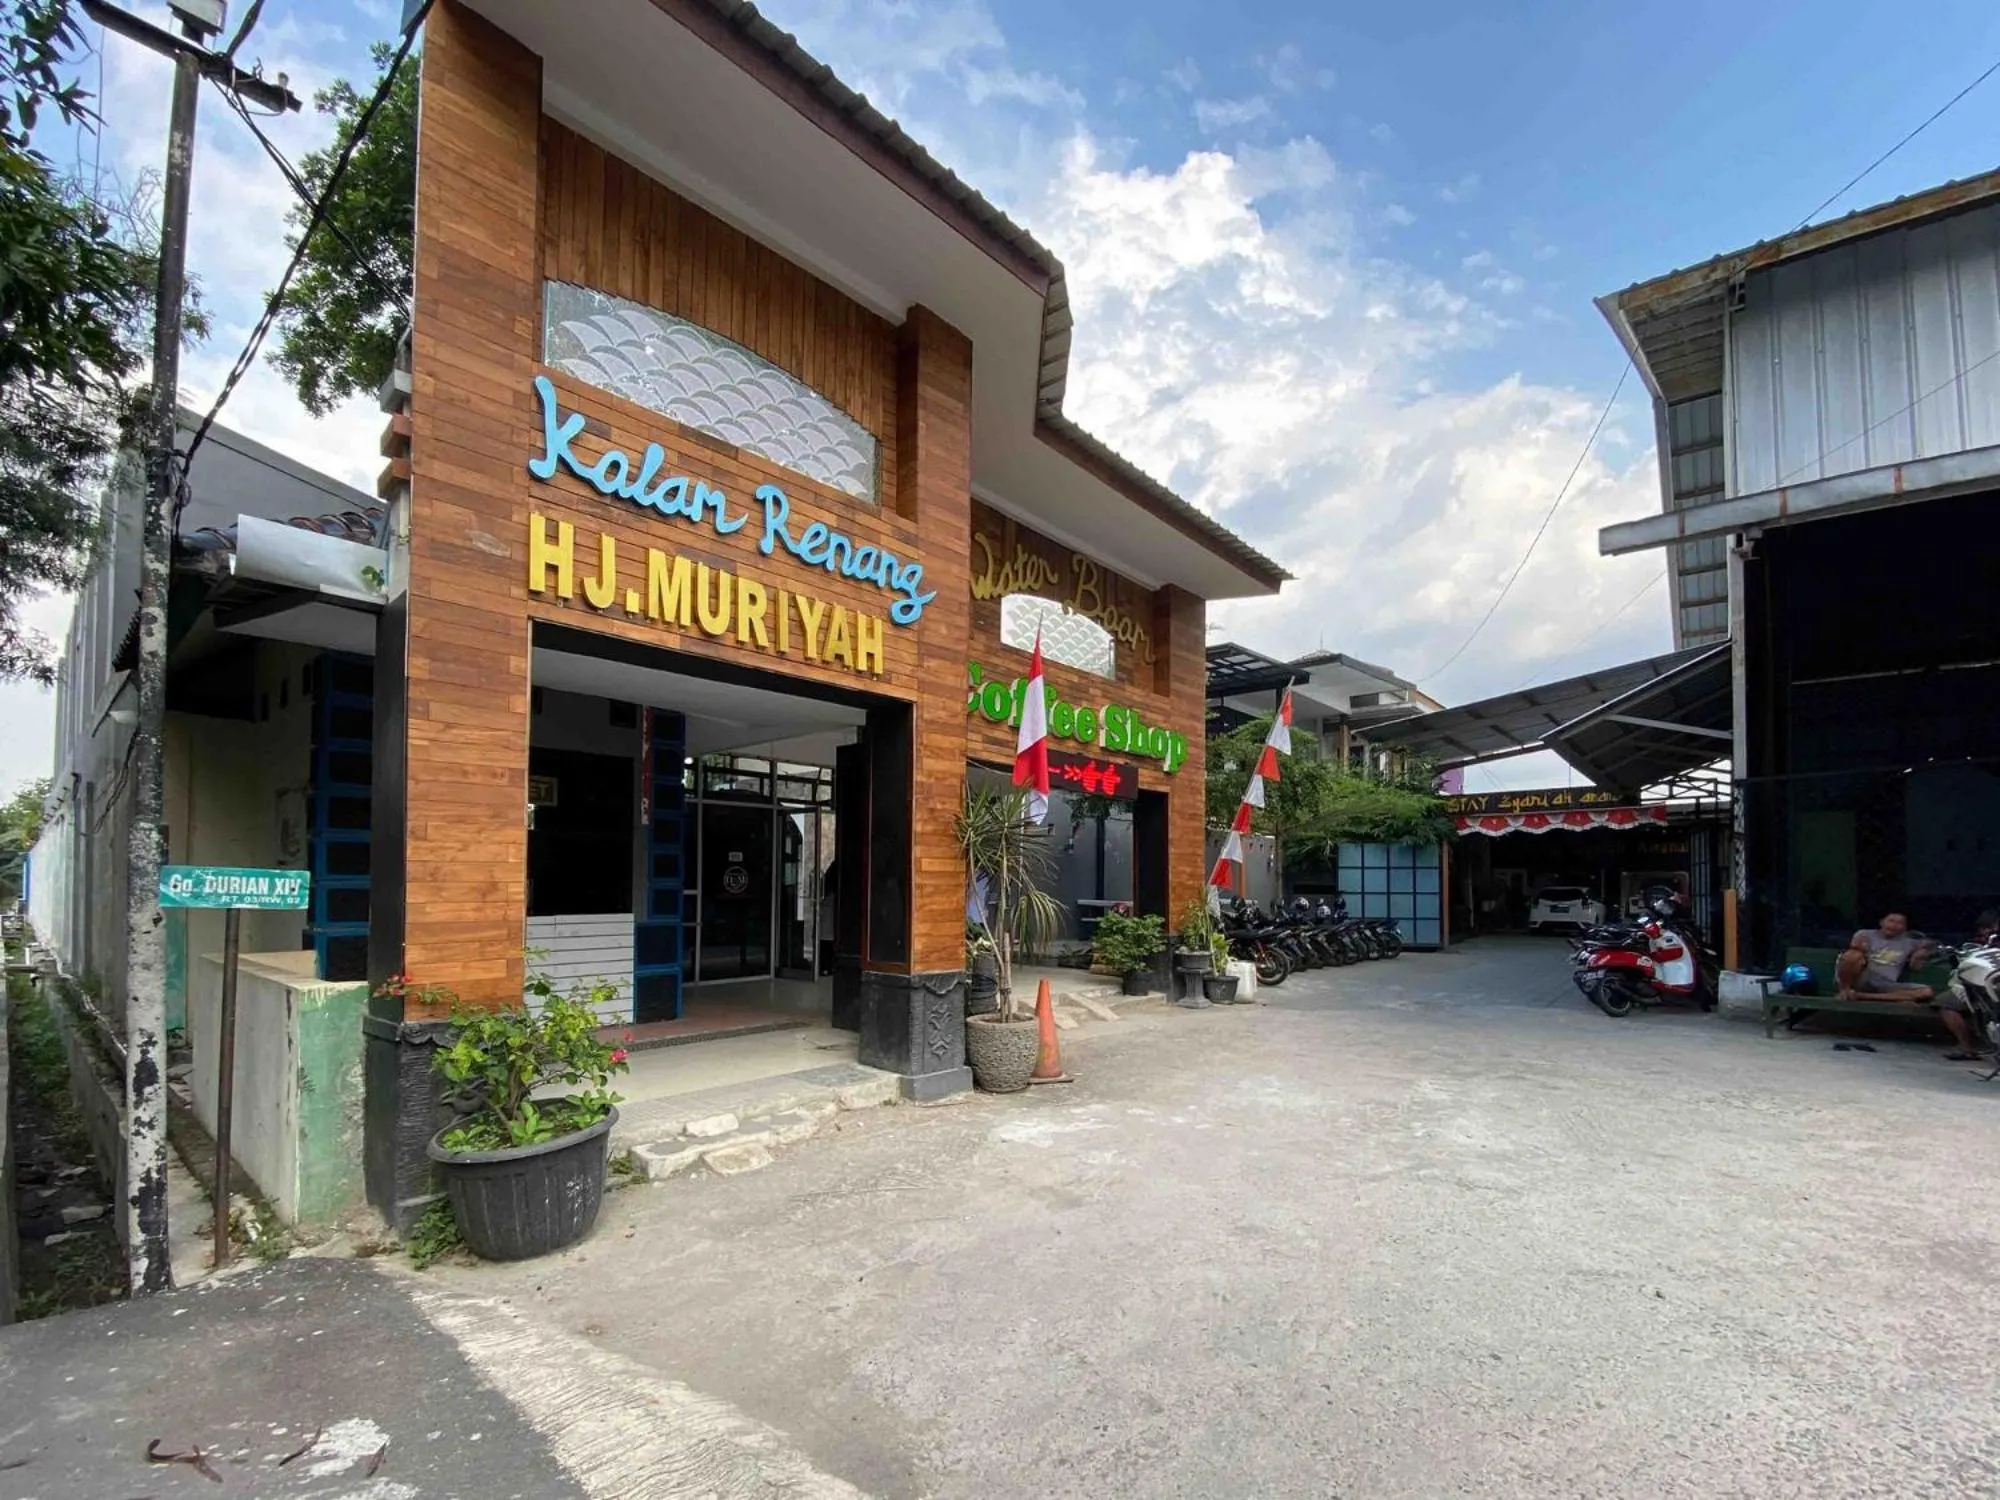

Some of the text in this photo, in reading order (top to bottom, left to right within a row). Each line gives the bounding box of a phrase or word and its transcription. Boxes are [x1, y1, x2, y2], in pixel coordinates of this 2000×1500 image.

[528, 376, 937, 626] Kalam Renang
[1100, 703, 1188, 773] Shop
[204, 876, 269, 895] DURIAN
[274, 878, 302, 895] XIV
